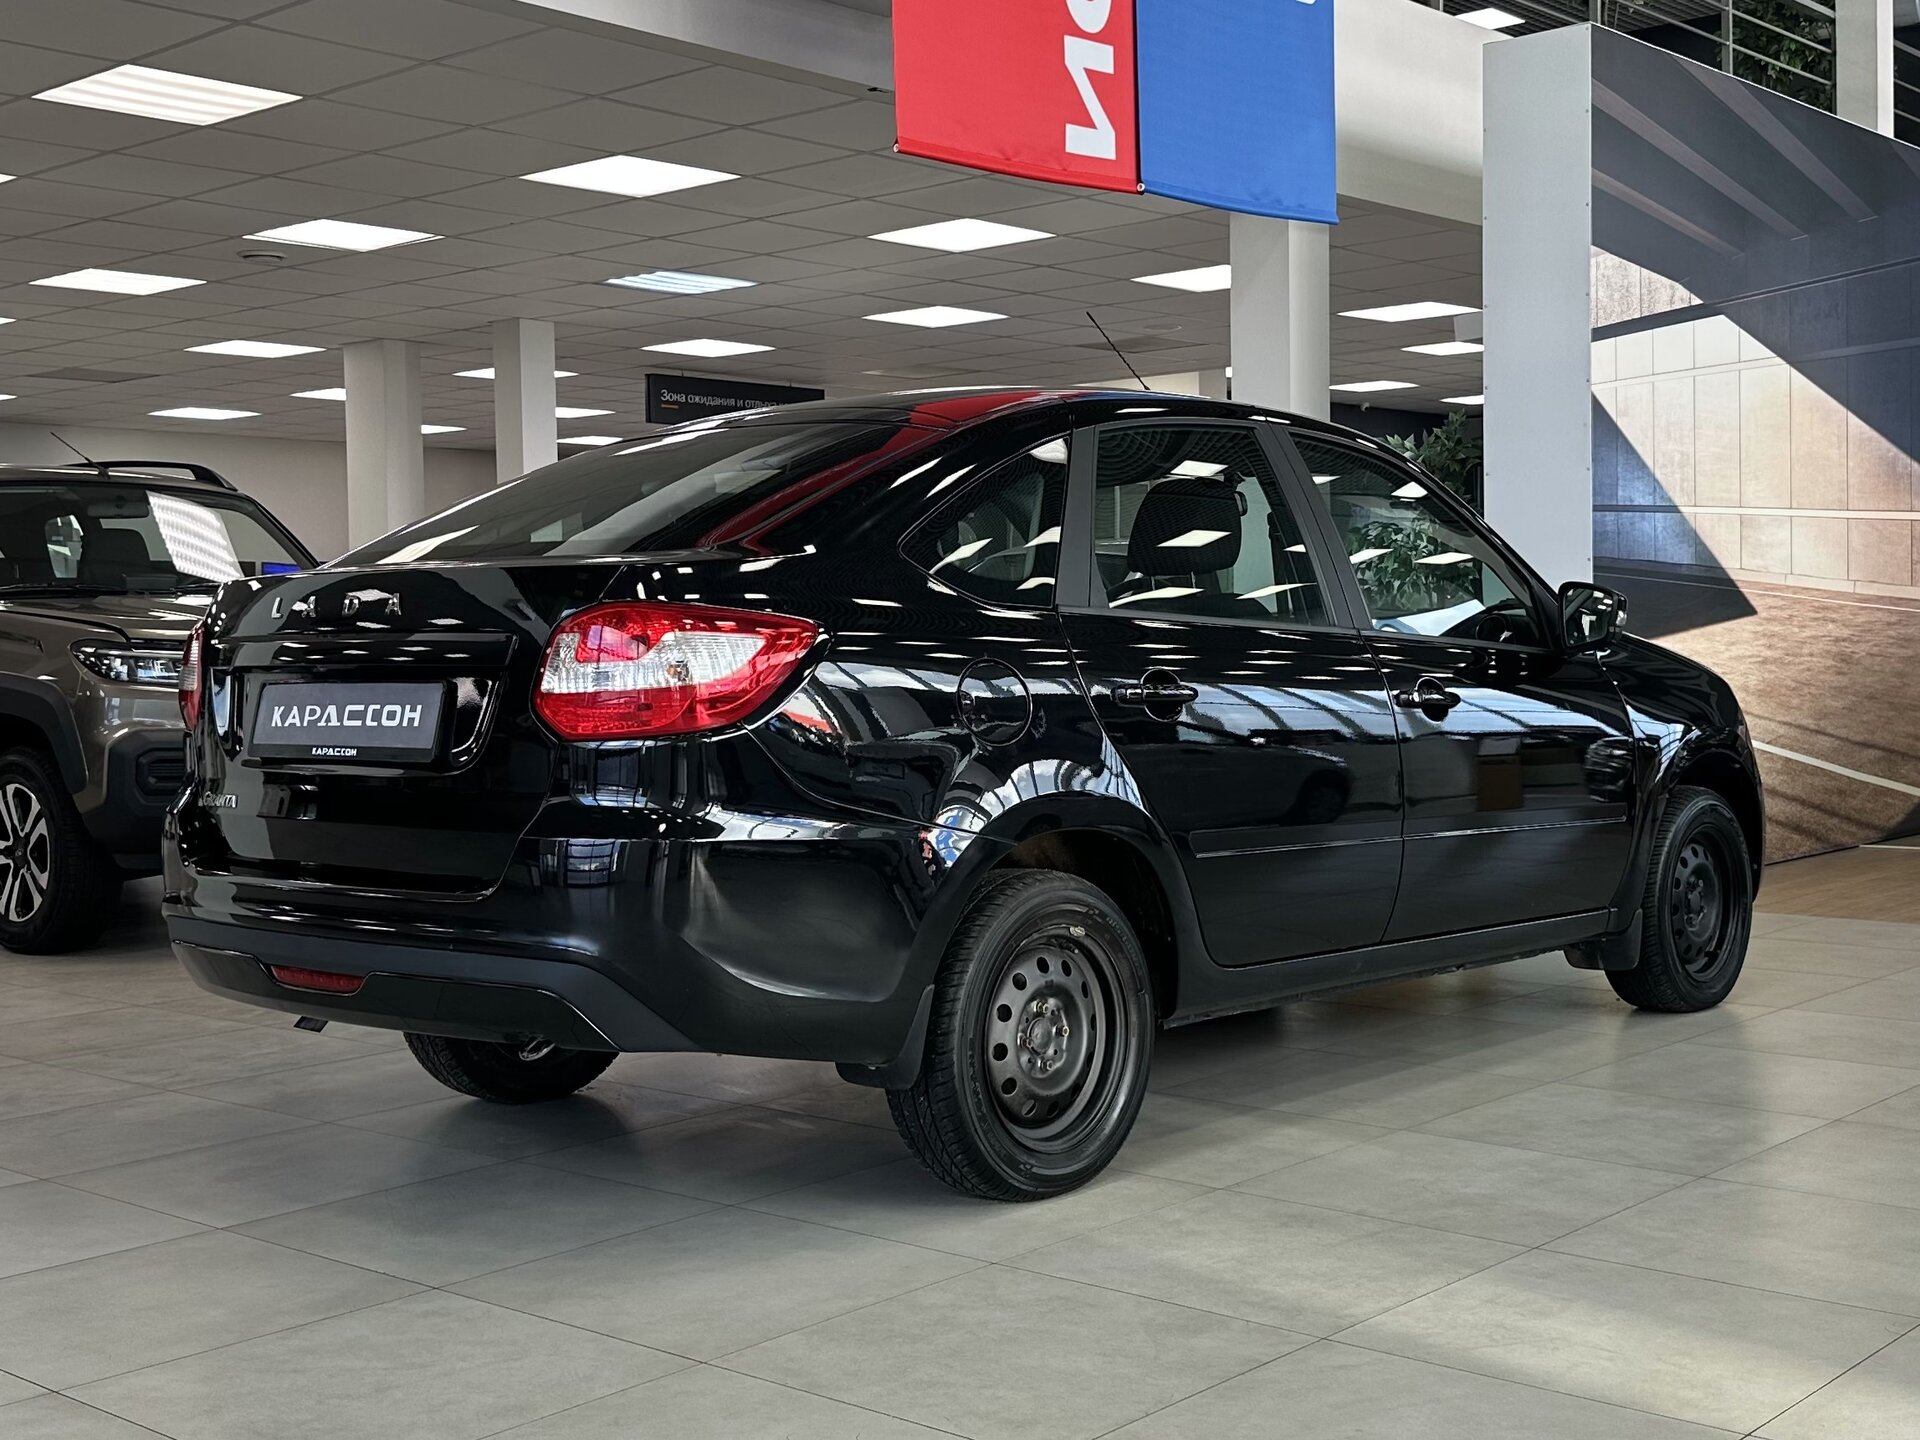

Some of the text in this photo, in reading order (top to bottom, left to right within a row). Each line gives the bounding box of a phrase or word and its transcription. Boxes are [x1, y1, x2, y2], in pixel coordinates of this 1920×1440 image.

[660, 389, 686, 404] Зона
[687, 394, 735, 407] ожидания
[737, 399, 743, 407] и
[271, 592, 402, 619] LADA
